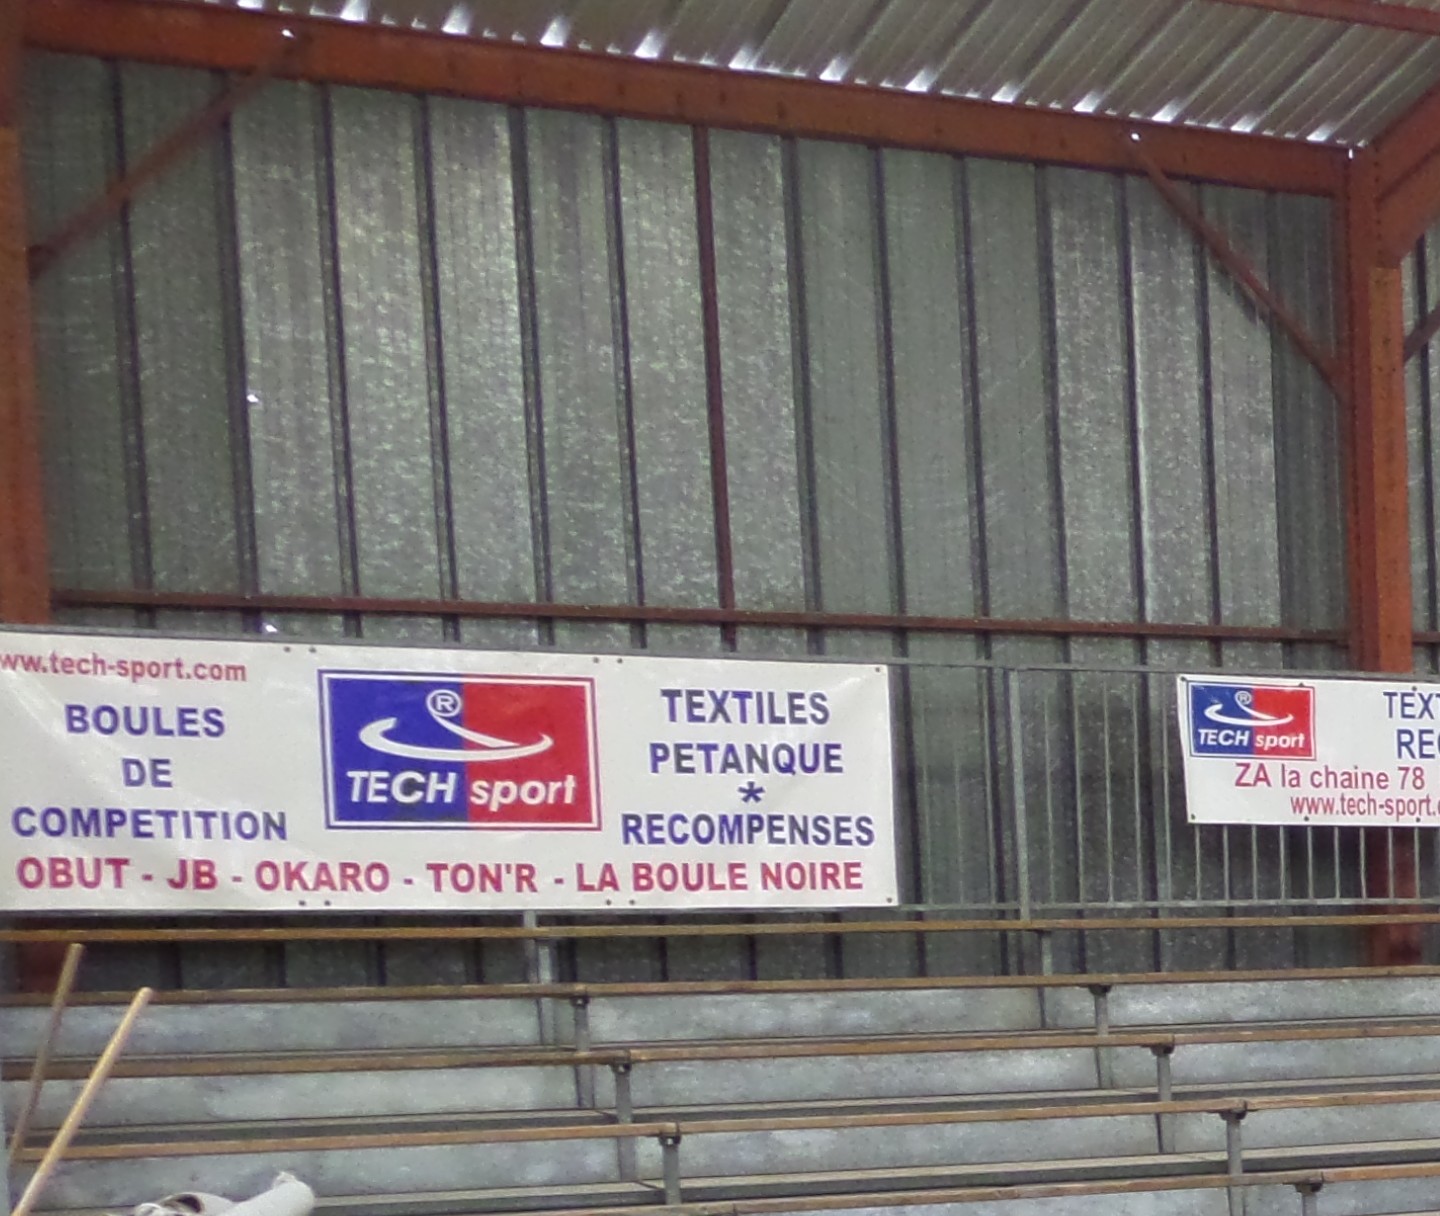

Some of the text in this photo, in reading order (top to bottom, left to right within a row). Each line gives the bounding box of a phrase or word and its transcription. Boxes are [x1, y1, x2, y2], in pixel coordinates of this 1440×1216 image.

[65, 704, 225, 737] BOULES
[660, 688, 830, 725] TEXTILES
[1198, 728, 1305, 750] TECH sport
[122, 757, 173, 788] DE
[649, 742, 843, 775] PETANQUE
[347, 771, 576, 811] TECH sport
[1235, 763, 1271, 787] ZA
[1281, 763, 1300, 787] la
[1310, 766, 1389, 790] chaine
[1398, 767, 1425, 790] 78
[12, 806, 288, 841] COMPETITION
[621, 813, 875, 846] RECOMPENSES
[16, 856, 130, 890] OBUT
[166, 858, 218, 890] JB
[254, 860, 390, 893] OKARO
[426, 862, 537, 894] TON'R
[576, 863, 620, 892] LA
[632, 862, 748, 892] BOULE
[761, 861, 863, 891] NOIRE
